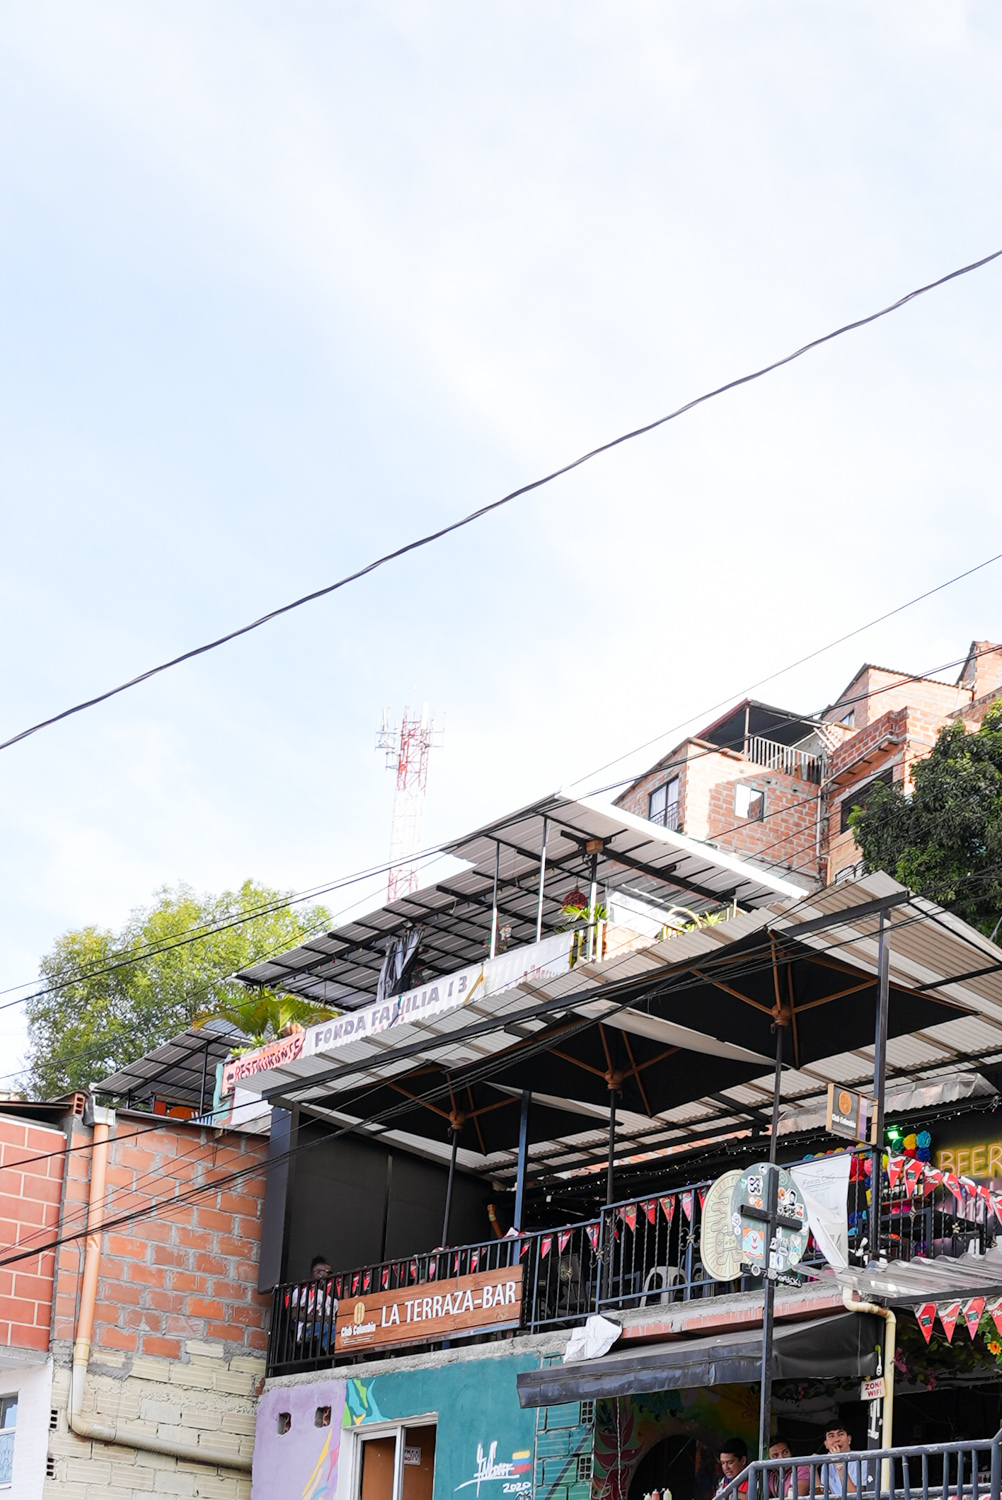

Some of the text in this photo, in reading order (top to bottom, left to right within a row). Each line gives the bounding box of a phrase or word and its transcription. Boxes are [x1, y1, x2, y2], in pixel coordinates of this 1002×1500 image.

[314, 1016, 366, 1048] FONDA
[381, 1281, 516, 1328] LA TERRAZA-BAR
[502, 1481, 531, 1493] 2020
